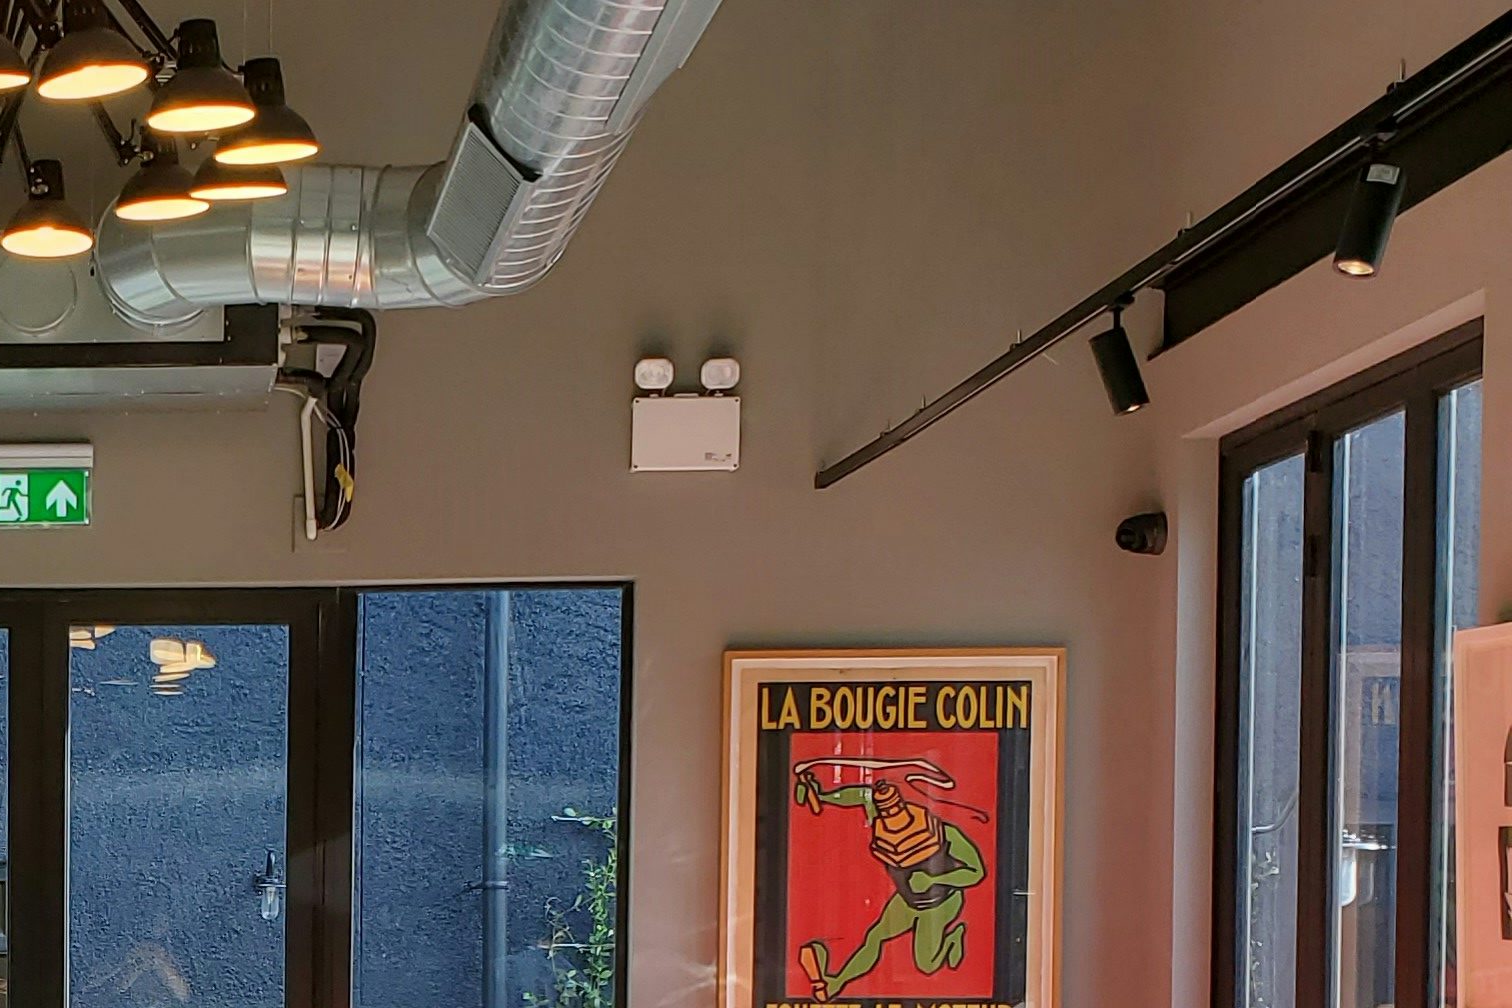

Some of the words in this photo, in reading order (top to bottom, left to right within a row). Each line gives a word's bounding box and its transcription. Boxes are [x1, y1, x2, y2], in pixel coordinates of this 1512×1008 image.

[761, 686, 800, 731] LA
[810, 686, 927, 731] BOUGIE
[936, 685, 1030, 730] COLIN
